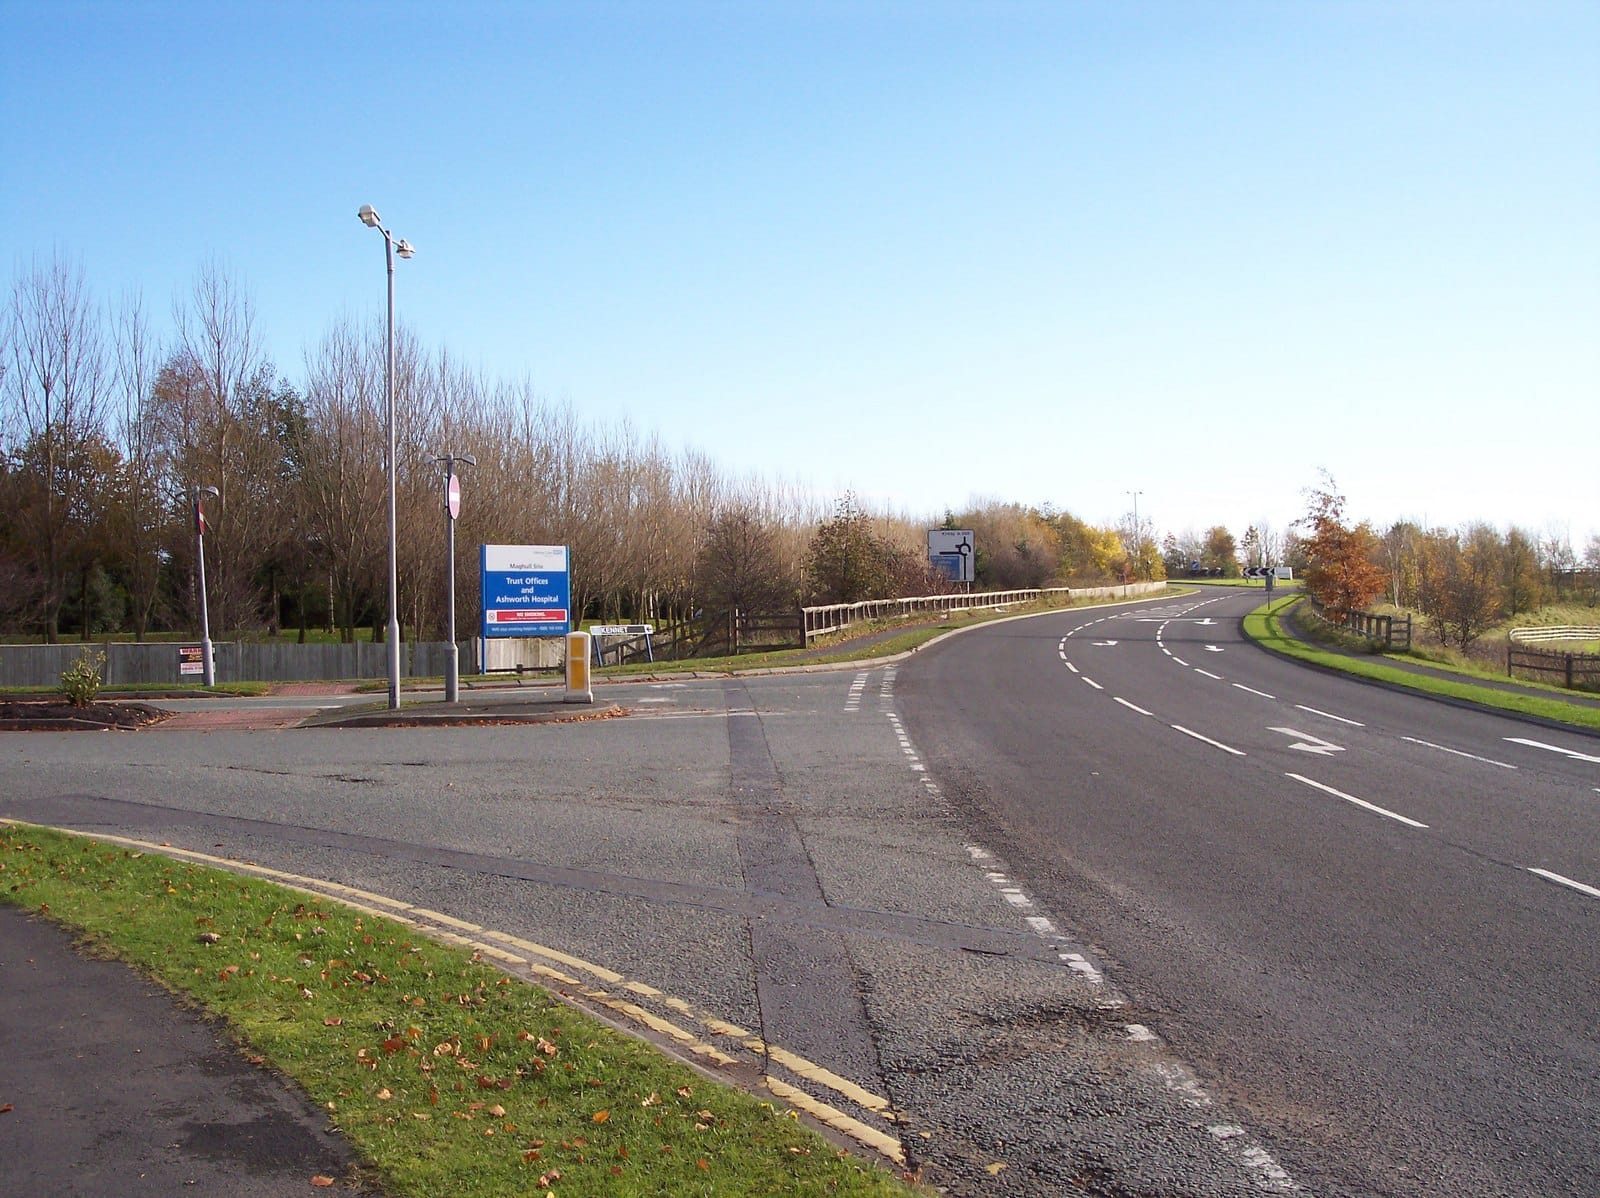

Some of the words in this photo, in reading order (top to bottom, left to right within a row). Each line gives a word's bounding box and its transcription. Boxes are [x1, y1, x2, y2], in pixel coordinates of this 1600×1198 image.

[505, 577, 523, 585] Trust
[525, 577, 549, 585] Offices
[521, 586, 534, 594] and
[496, 595, 530, 603] Ashworth
[531, 595, 559, 604] Hospital
